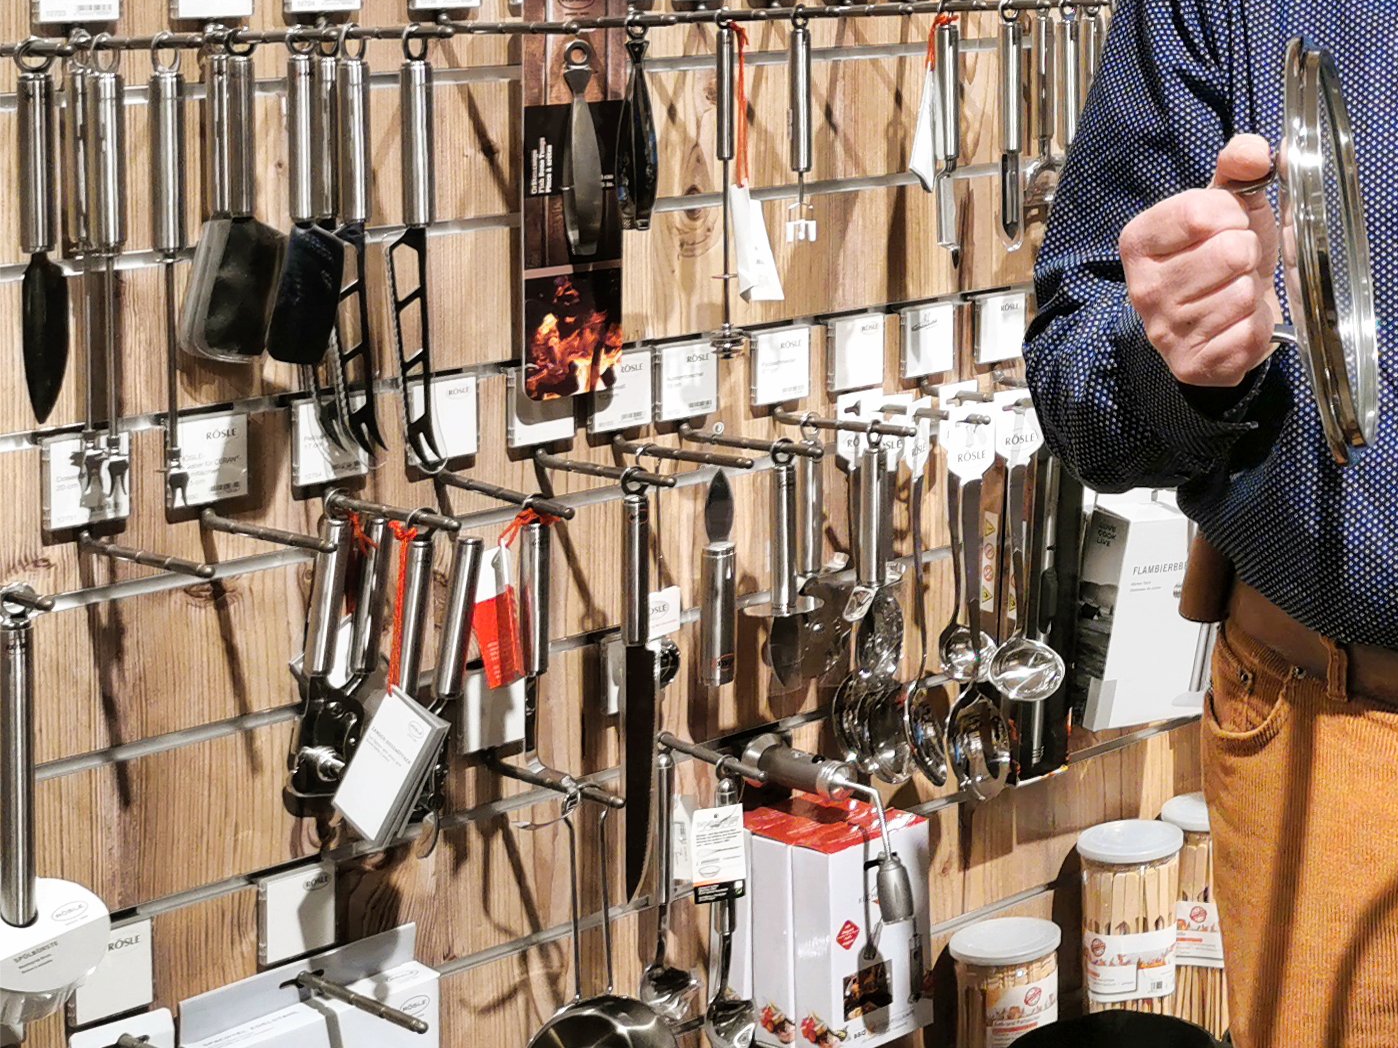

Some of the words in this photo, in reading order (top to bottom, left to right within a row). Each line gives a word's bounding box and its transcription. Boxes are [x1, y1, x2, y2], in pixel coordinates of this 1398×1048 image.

[780, 339, 803, 349] RÖSLE
[686, 353, 710, 364] RÖSLE
[205, 427, 238, 440] RÖSLE
[1004, 434, 1035, 446] RÖSLE
[957, 449, 986, 463] RÖSLE
[305, 874, 329, 888] RÖSLE
[55, 903, 83, 919] RÖSLE
[107, 934, 141, 952] RÖSLE
